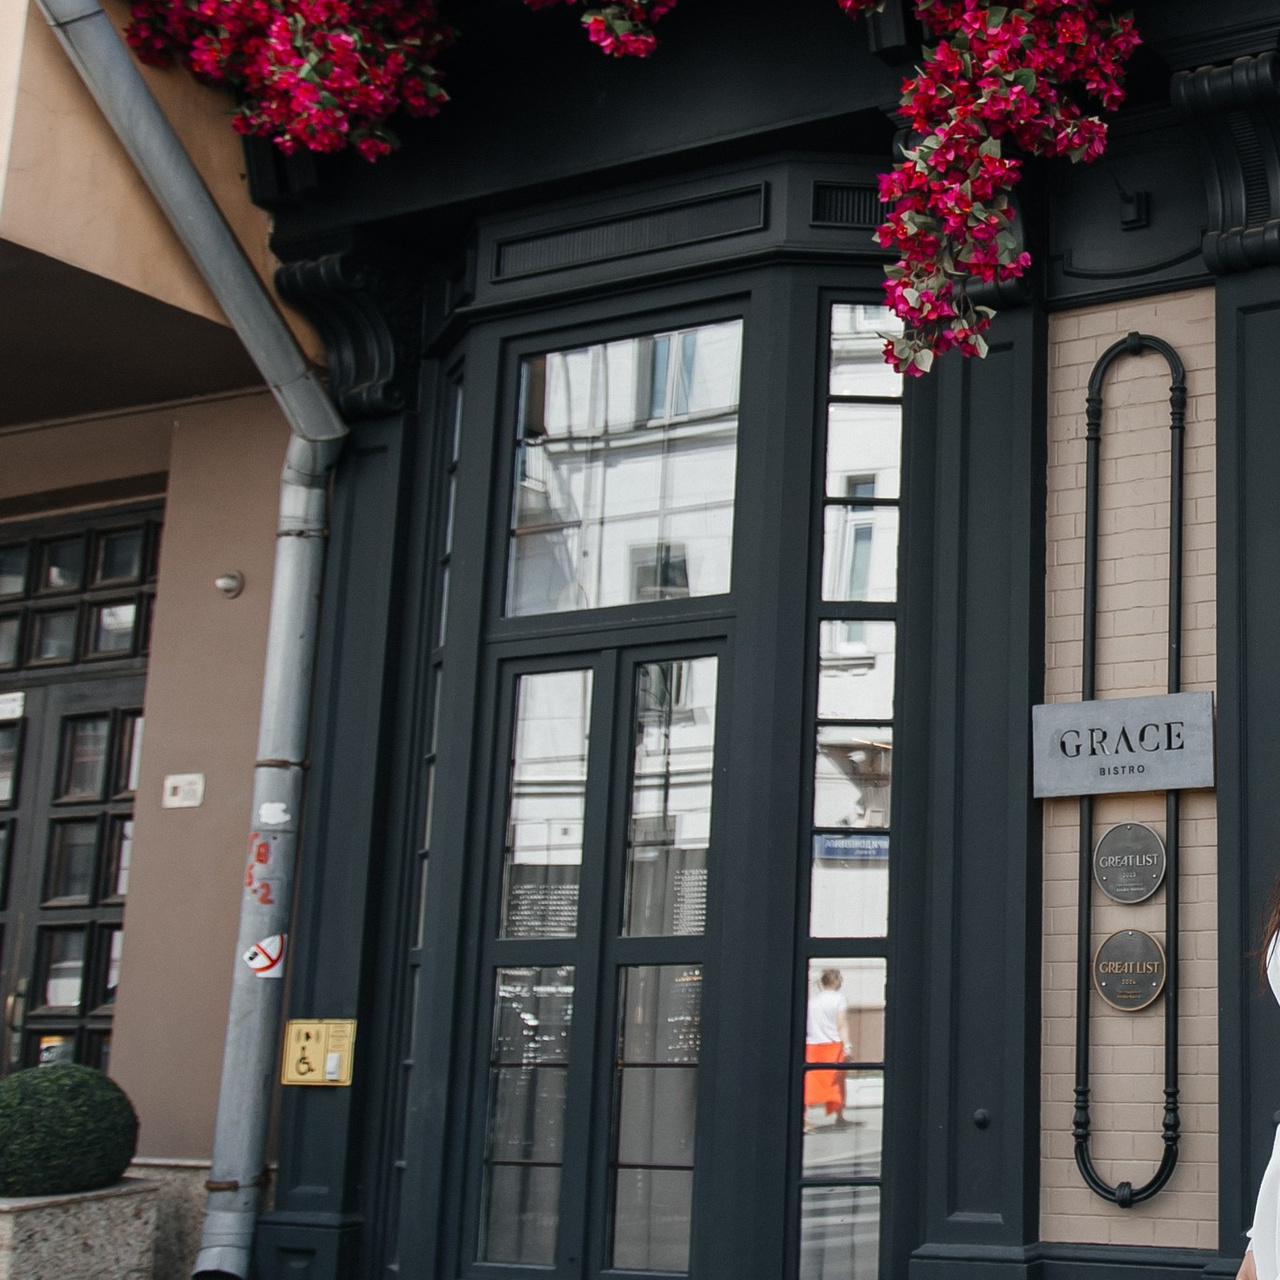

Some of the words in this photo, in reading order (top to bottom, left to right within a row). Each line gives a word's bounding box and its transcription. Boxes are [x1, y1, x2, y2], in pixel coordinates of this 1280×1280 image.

[1060, 721, 1185, 758] GRACE
[1100, 765, 1145, 776] BISTRO
[1099, 855, 1134, 868] GREAT
[1136, 854, 1159, 866] LIST
[1099, 961, 1135, 974] GREAT
[1136, 961, 1159, 974] LIST
